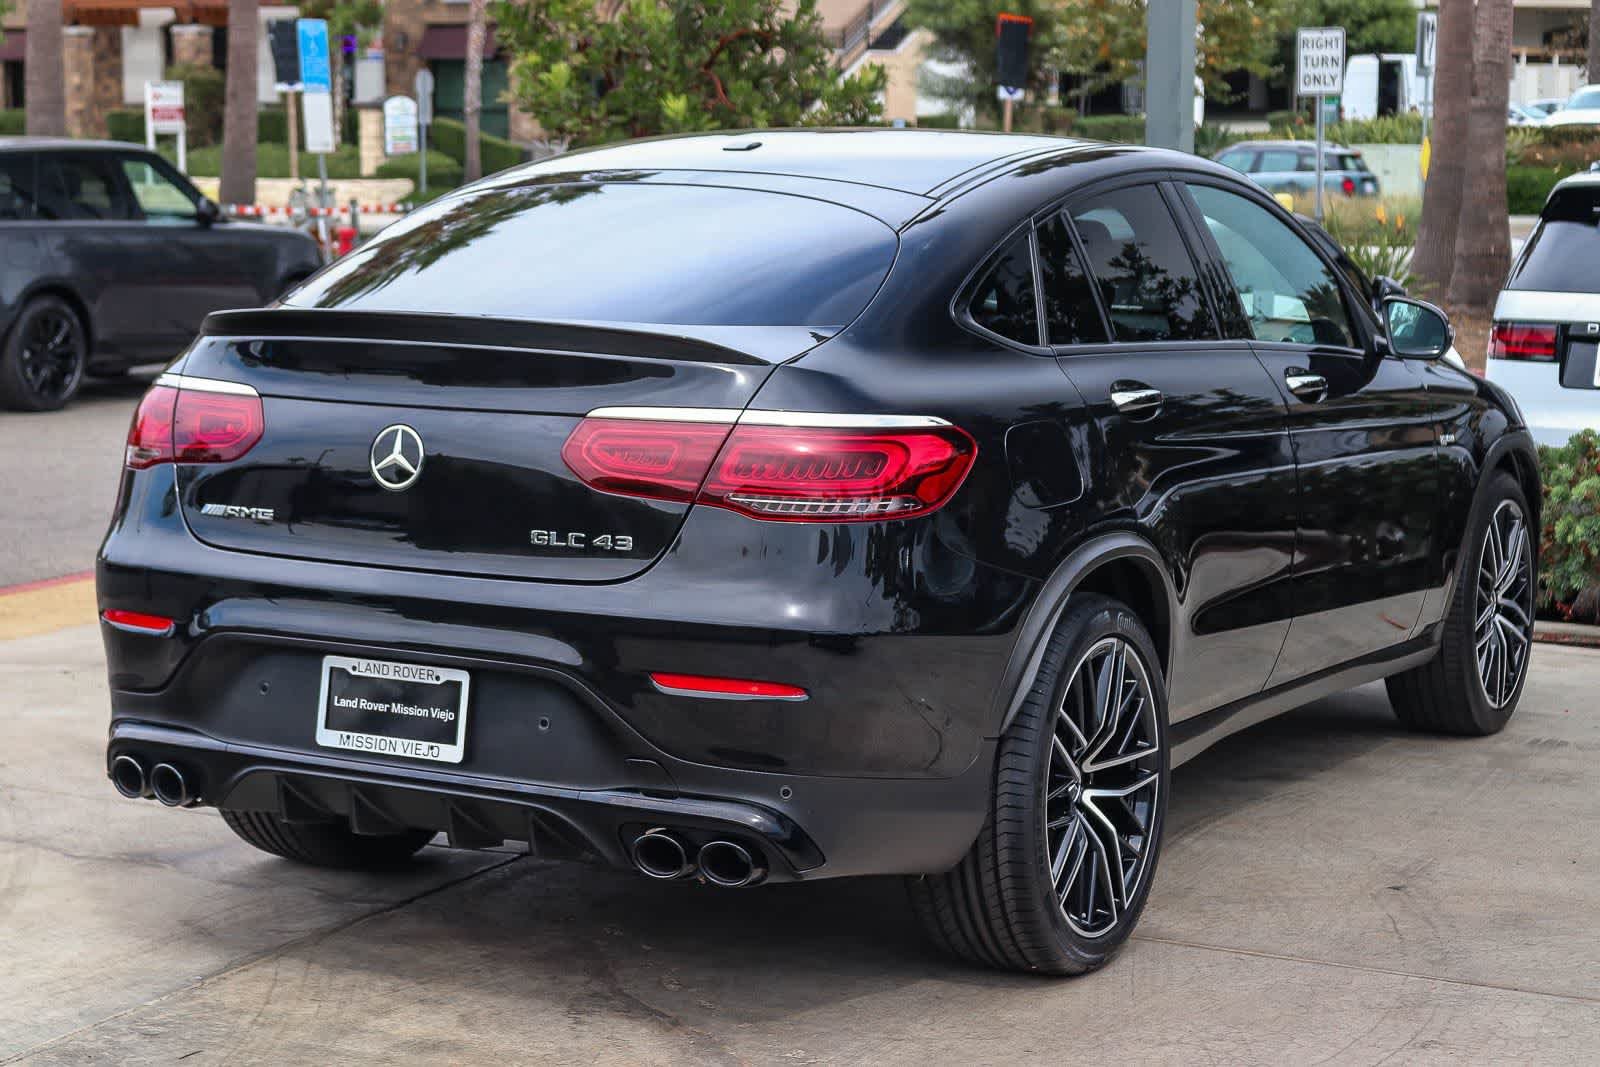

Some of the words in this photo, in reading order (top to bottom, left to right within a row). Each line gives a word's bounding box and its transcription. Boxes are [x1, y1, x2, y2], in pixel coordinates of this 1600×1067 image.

[1302, 37, 1340, 49] RIGHT
[1303, 55, 1340, 68] TURN
[1303, 73, 1338, 87] ONLY
[530, 529, 586, 548] GLC
[592, 534, 633, 551] 43
[357, 661, 390, 676] LAND
[393, 666, 435, 680] ROVER
[333, 695, 358, 708] Land
[359, 699, 390, 712] Rover
[391, 702, 429, 718] Mission
[430, 707, 455, 723] Viejo
[339, 734, 397, 752] MISSION
[401, 742, 440, 758] VIEJO
